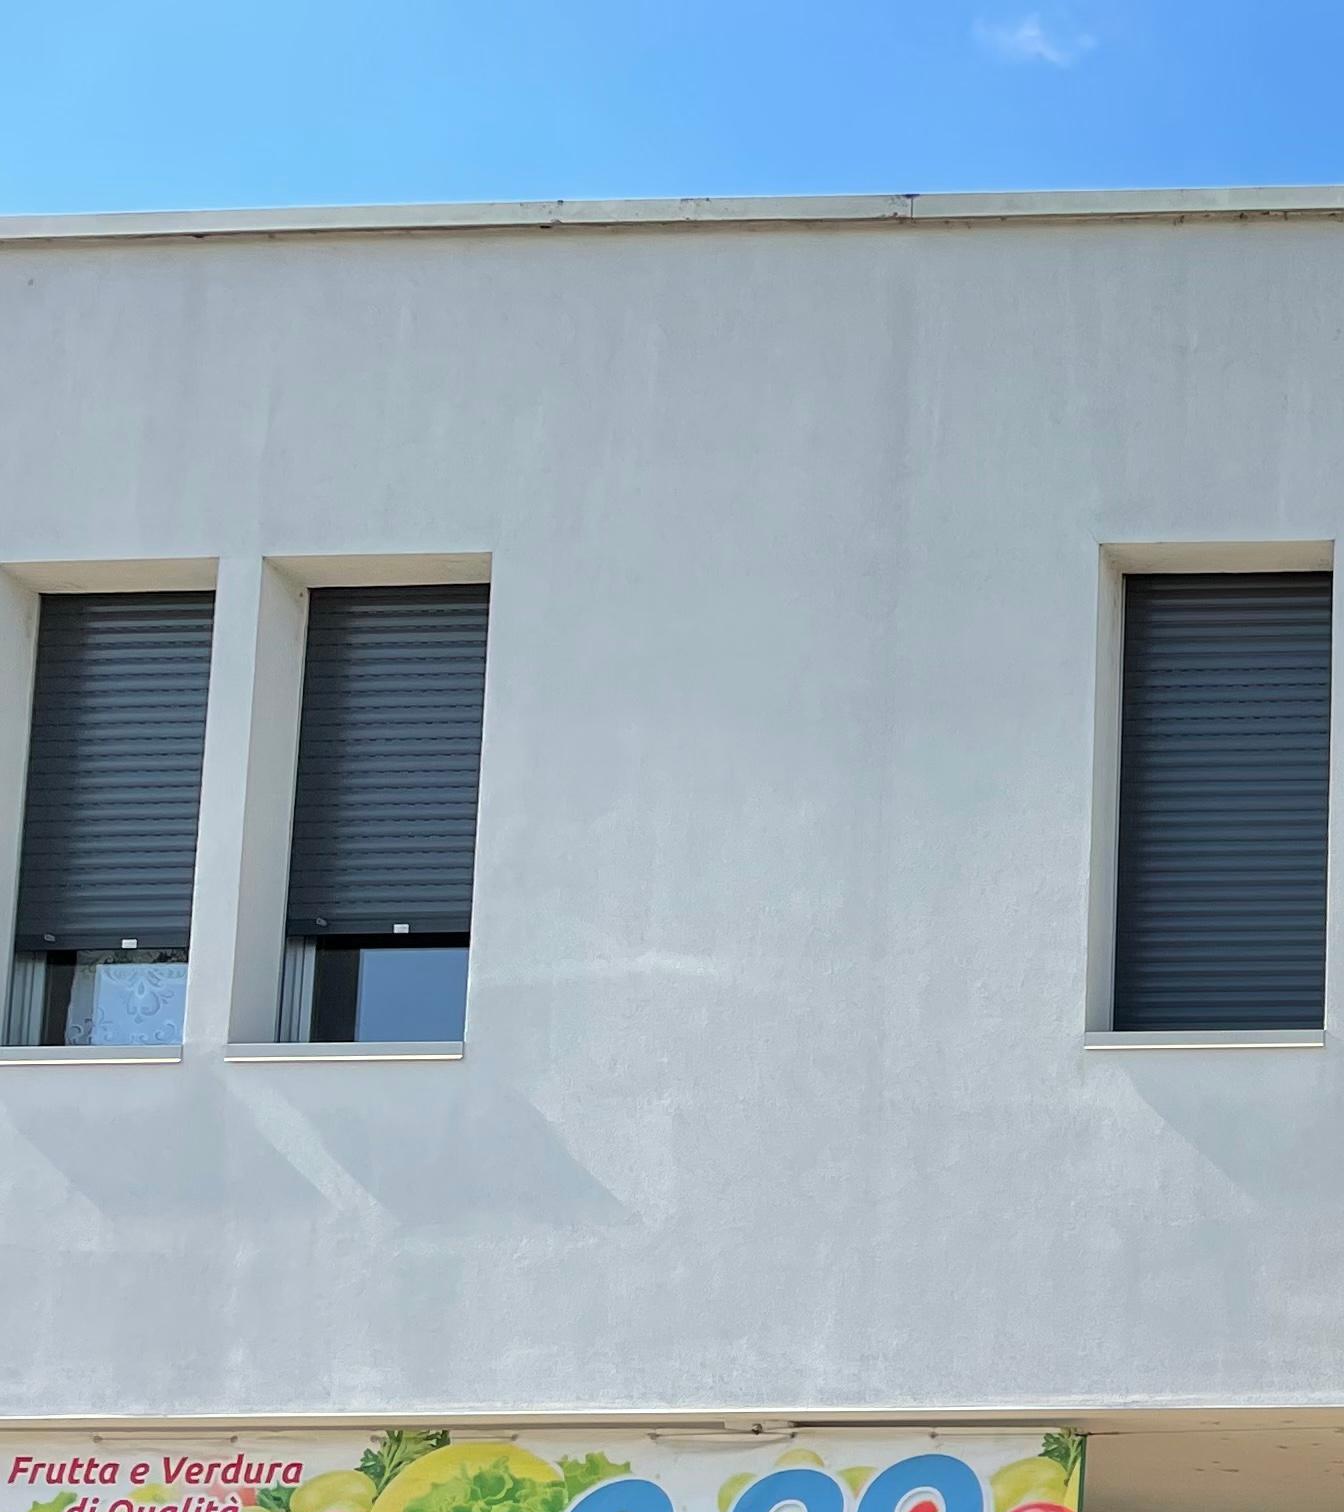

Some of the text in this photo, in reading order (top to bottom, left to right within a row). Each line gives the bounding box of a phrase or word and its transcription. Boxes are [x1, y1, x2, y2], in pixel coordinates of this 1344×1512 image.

[7, 1454, 304, 1485] Frutta e Verdura
